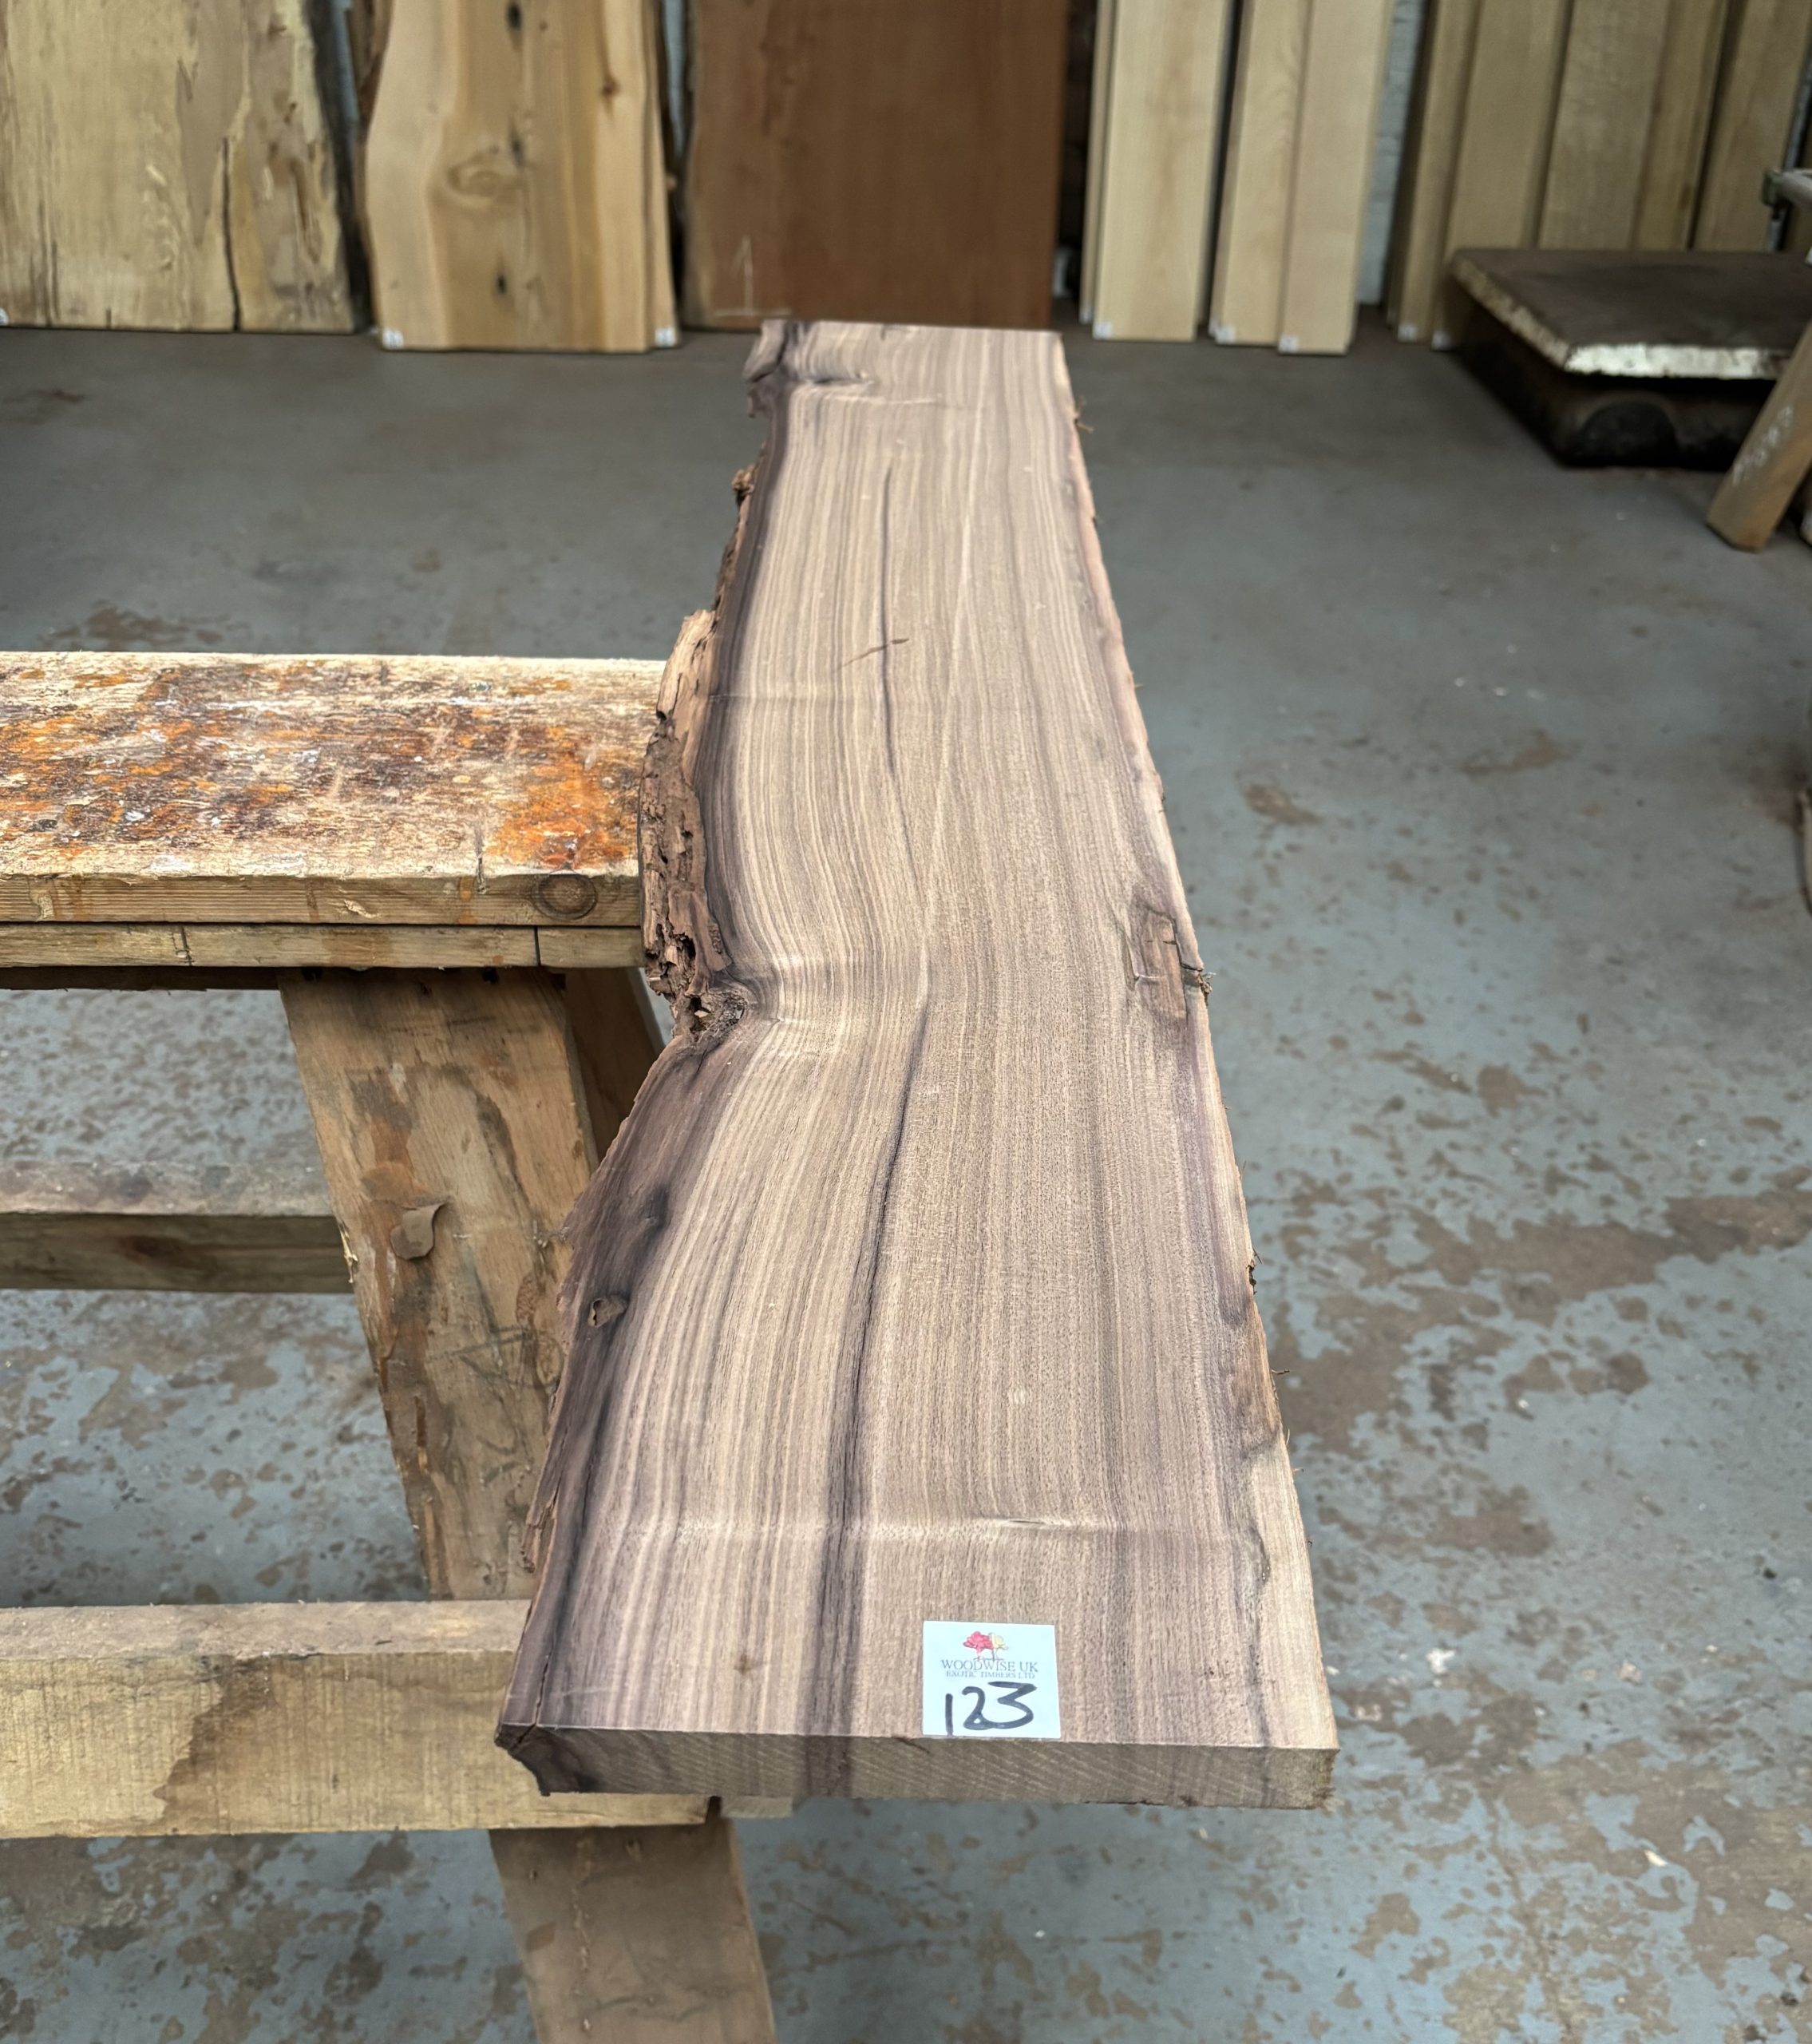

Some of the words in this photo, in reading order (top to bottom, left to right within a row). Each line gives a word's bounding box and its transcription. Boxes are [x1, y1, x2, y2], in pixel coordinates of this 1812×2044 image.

[941, 1659, 1016, 1671] WOODWISE
[1019, 1661, 1039, 1672] UK
[945, 1681, 1037, 1736] 123
